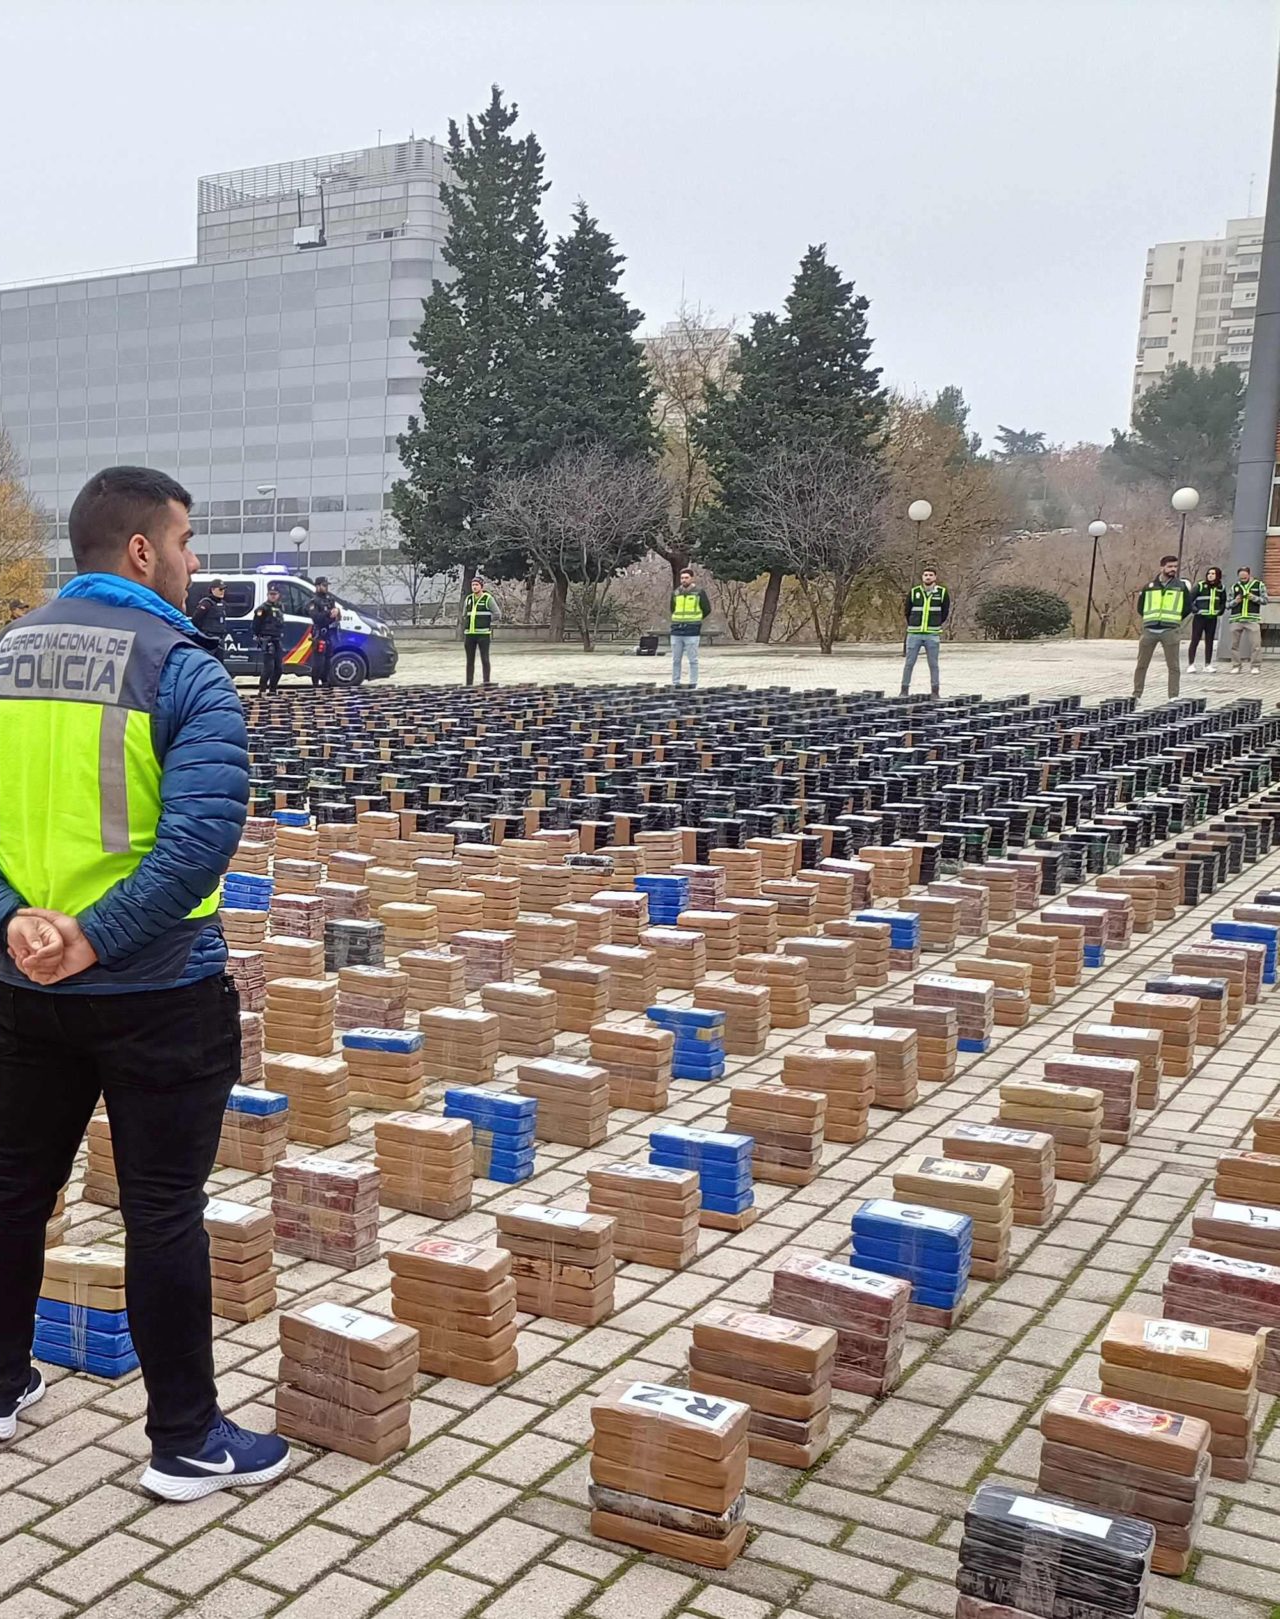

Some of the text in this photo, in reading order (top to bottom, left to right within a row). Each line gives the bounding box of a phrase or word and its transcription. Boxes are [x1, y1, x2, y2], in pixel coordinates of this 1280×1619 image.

[0, 632, 128, 656] CUERPO NACIONAL DE
[816, 1264, 886, 1288] LOVE
[631, 1385, 728, 1422] R-Z
